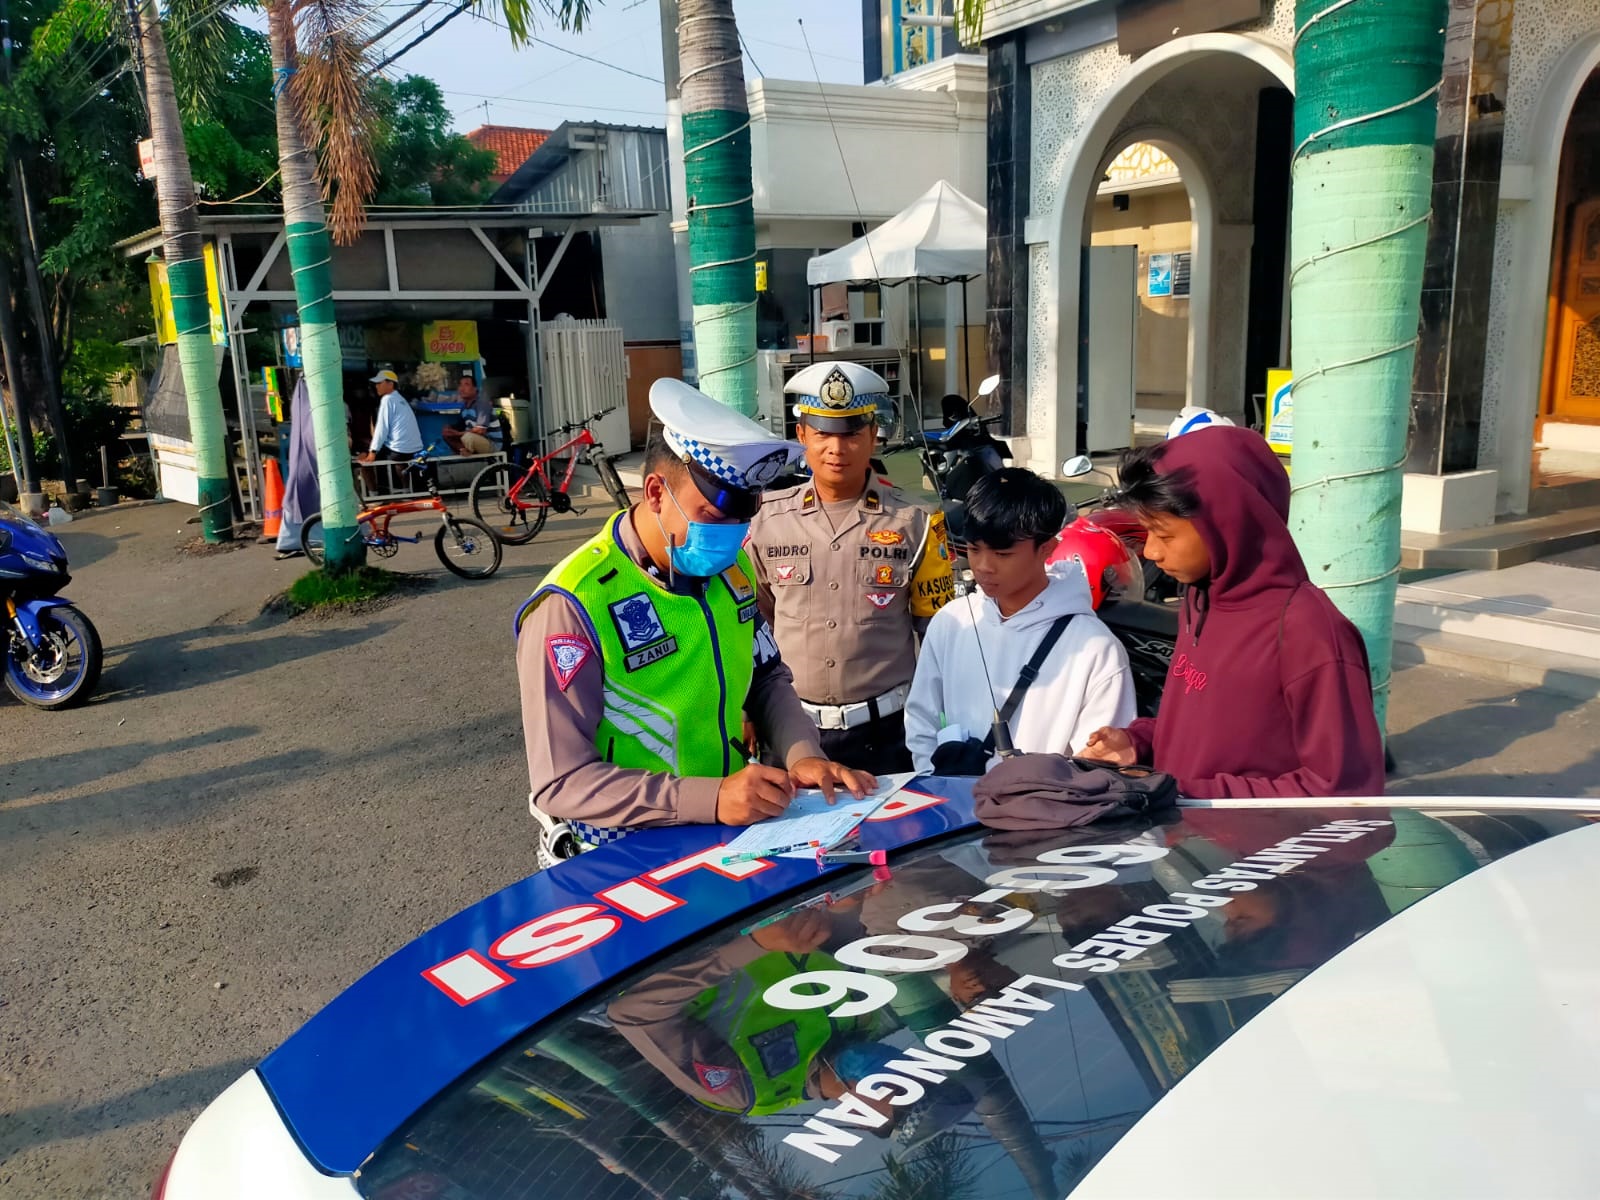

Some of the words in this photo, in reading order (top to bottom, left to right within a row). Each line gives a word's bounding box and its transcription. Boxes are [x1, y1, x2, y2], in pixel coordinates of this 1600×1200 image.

[766, 544, 809, 558] ENDRO
[859, 545, 908, 561] POLRI
[637, 642, 670, 666] ZANU
[1191, 818, 1394, 893] SATLANTAS
[420, 788, 950, 1007] PLISI
[1051, 891, 1234, 973] POLRES
[781, 973, 1085, 1164] LAMONGAN
